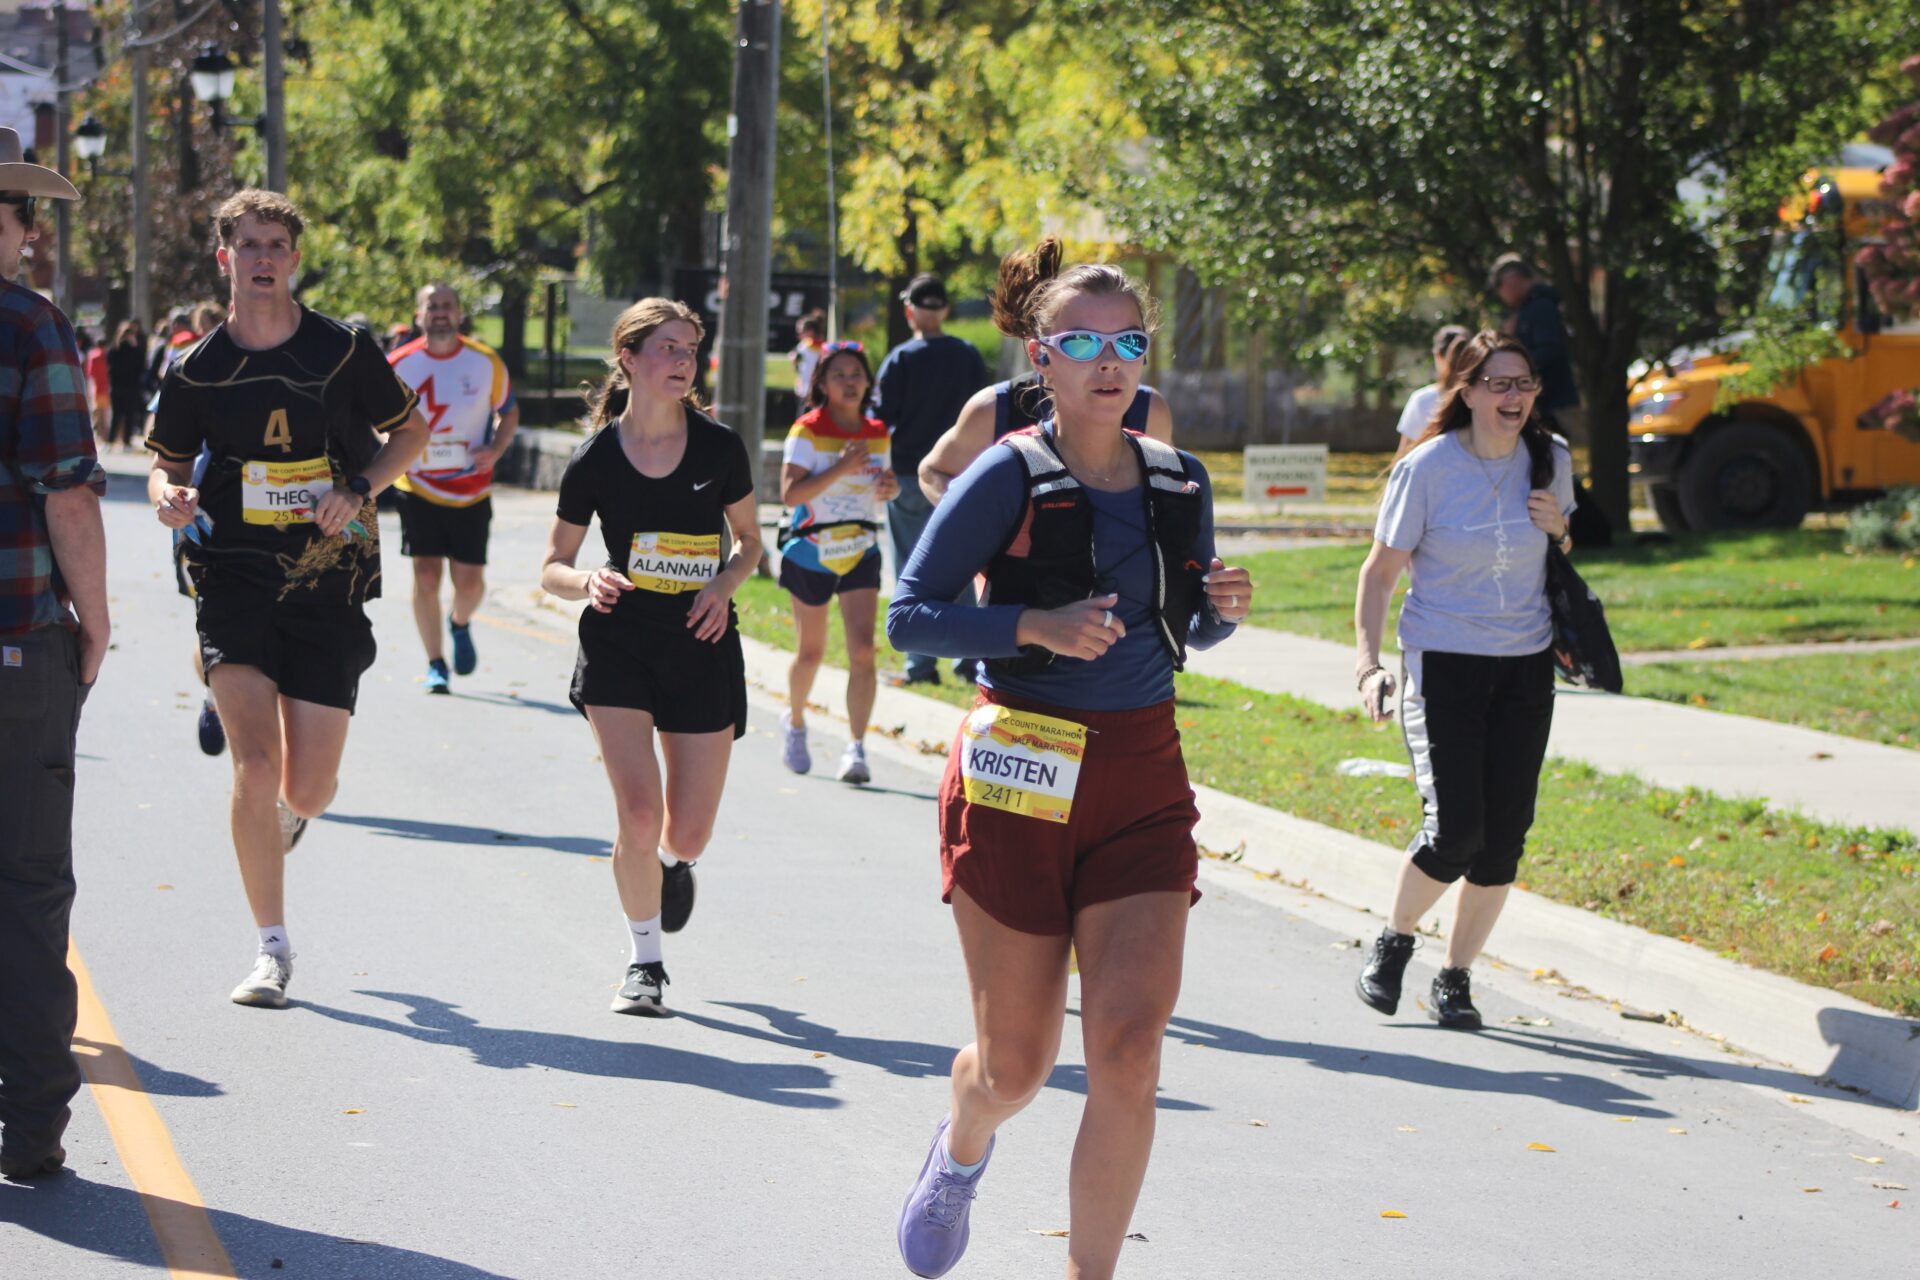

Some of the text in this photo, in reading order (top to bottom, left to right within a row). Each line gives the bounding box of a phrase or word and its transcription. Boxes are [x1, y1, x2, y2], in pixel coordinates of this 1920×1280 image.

[263, 408, 293, 453] 4
[1256, 472, 1316, 481] PARKING
[633, 558, 713, 578] ALANNAH
[654, 578, 688, 592] 2517
[1010, 718, 1039, 731] COUNTY
[1040, 725, 1082, 740] MARATHON
[1011, 735, 1078, 756] HALF MARATHON
[969, 747, 1058, 788] KRISTEN
[982, 783, 1023, 808] 2411
